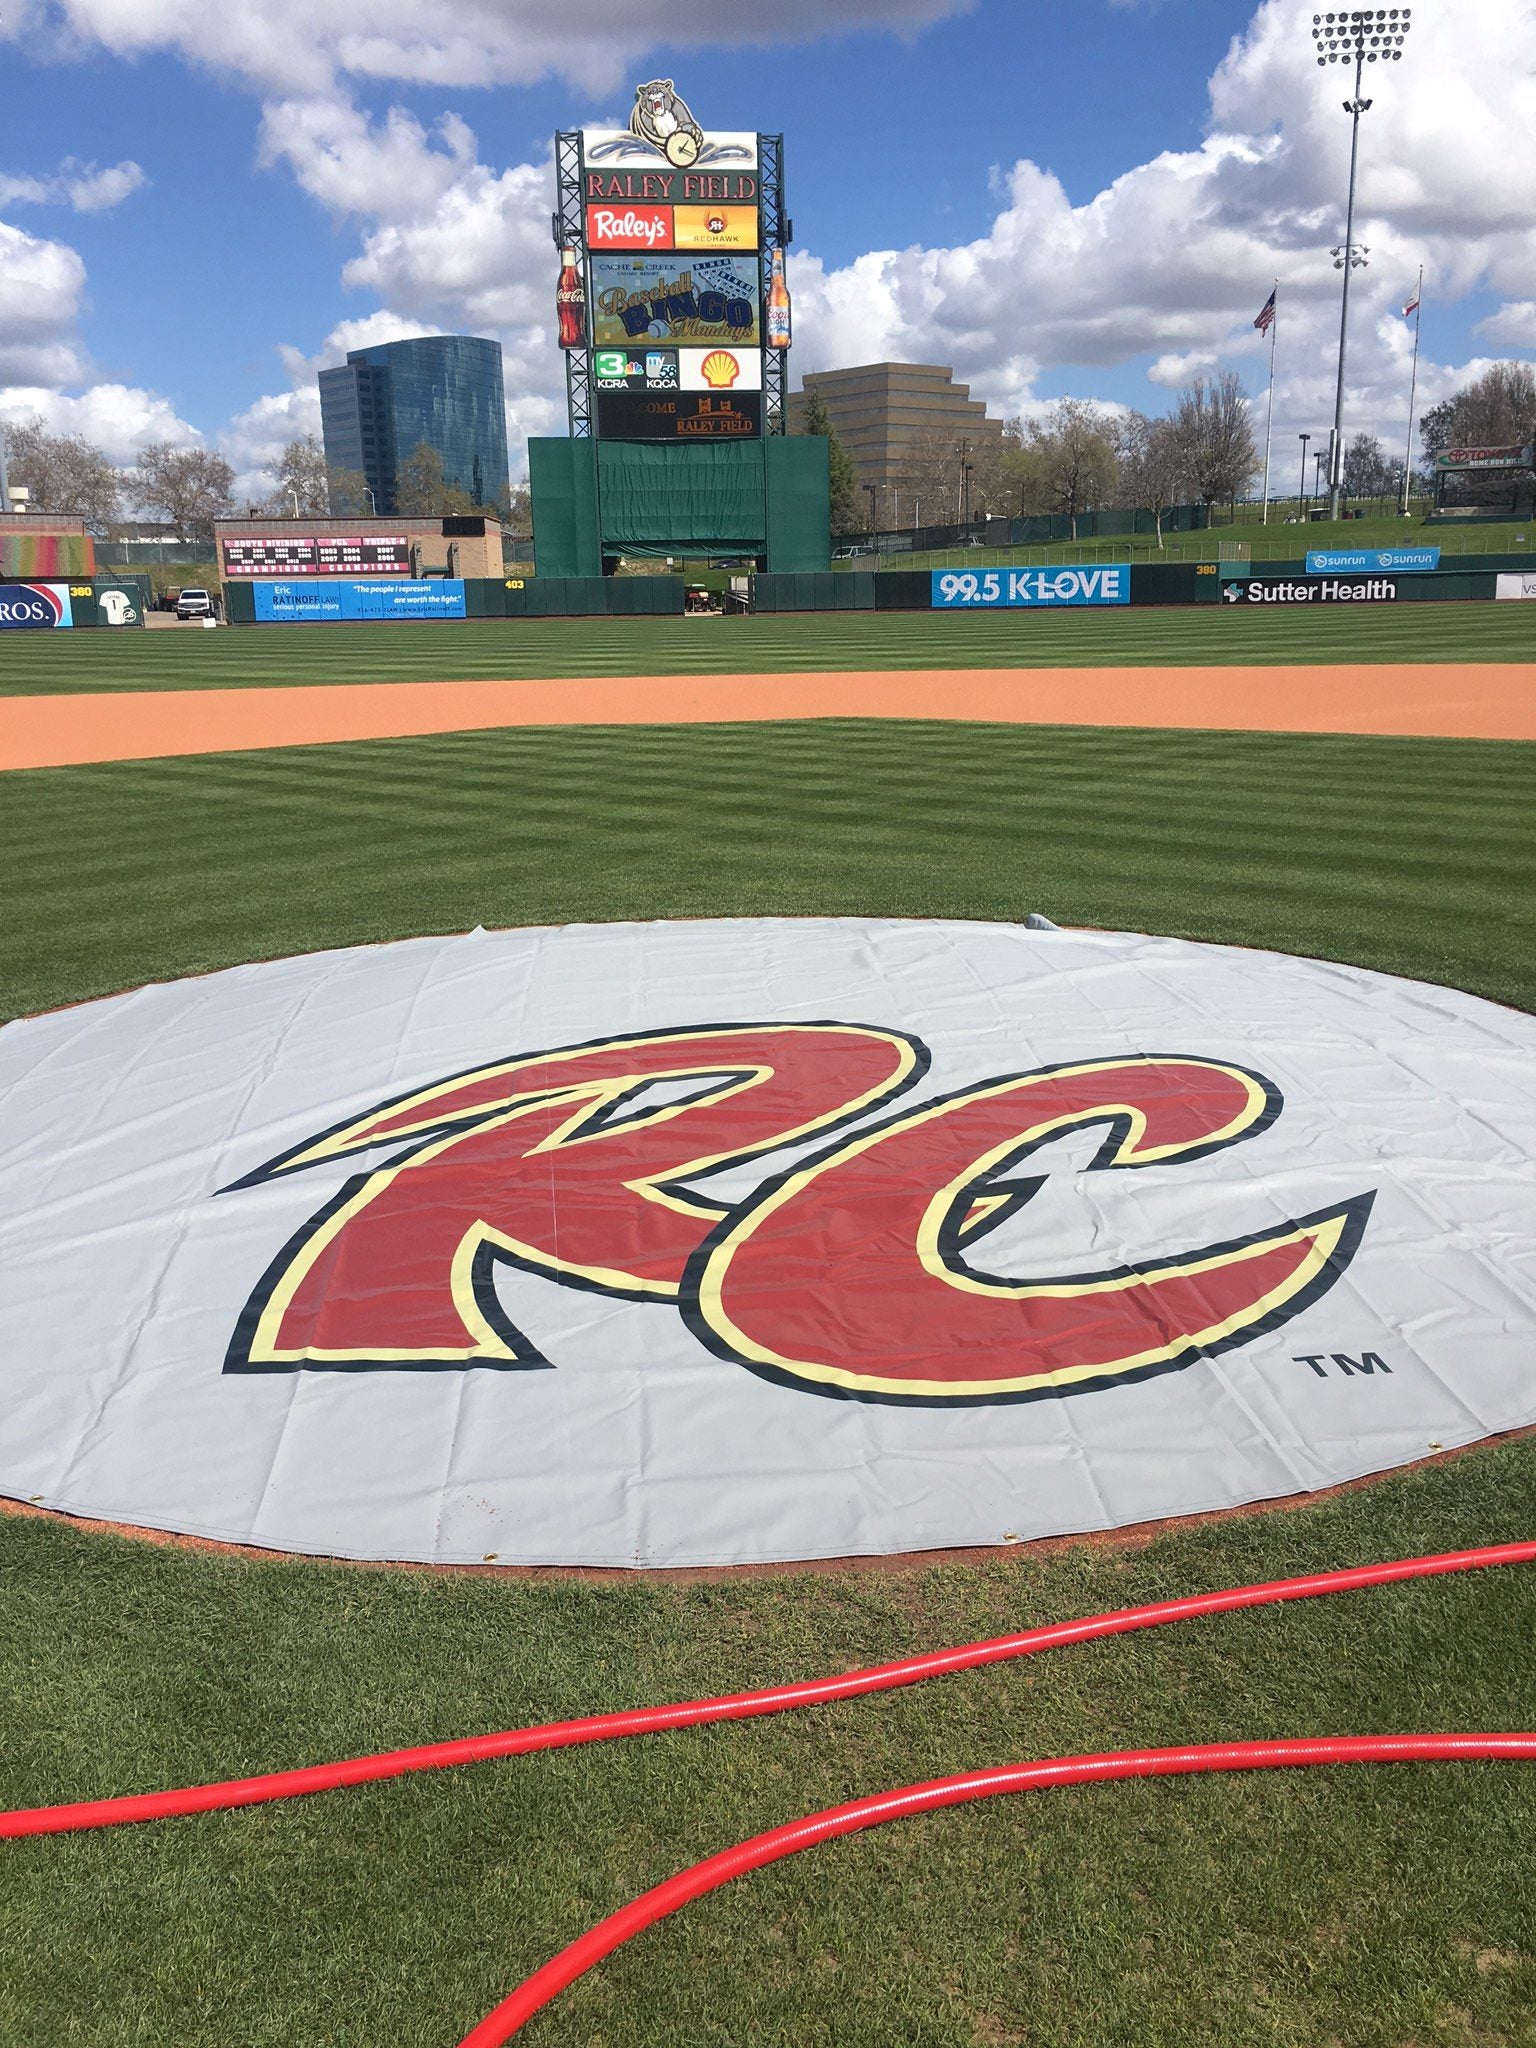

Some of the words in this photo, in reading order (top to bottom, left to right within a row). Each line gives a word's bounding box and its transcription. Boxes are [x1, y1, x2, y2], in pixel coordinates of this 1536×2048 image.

[587, 174, 674, 199] RALEY
[683, 175, 756, 200] FIELD
[594, 211, 665, 245] Raley's
[694, 235, 739, 243] REDHAWK
[599, 263, 631, 271] CACHE
[645, 263, 677, 271] CREEK
[598, 270, 694, 317] Baseball
[617, 288, 754, 337] BINGO
[669, 316, 754, 342] Mondays
[600, 353, 624, 376] 3
[660, 365, 677, 378] 58
[597, 379, 629, 389] KCRA
[646, 379, 678, 389] KQCA
[677, 420, 715, 432] RALEY
[720, 420, 752, 432] FIELD
[1327, 556, 1366, 566] sunrun
[1393, 554, 1432, 564] sunrun
[236, 565, 307, 573] CHAMPIONS
[328, 562, 400, 572] CHAMPIONS
[1196, 565, 1217, 575] 380
[370, 585, 394, 594] people
[399, 585, 431, 593] represent
[505, 580, 524, 589] 403
[940, 573, 1001, 601] 99.5
[70, 586, 92, 597] 380
[274, 586, 291, 595] Eric
[1248, 582, 1318, 603] Sutter
[1321, 579, 1396, 601] Health
[272, 595, 320, 605] RATINOFF
[406, 595, 428, 604] worth
[428, 595, 440, 603] the
[295, 603, 320, 611] personal
[1291, 1352, 1394, 1378] TM
